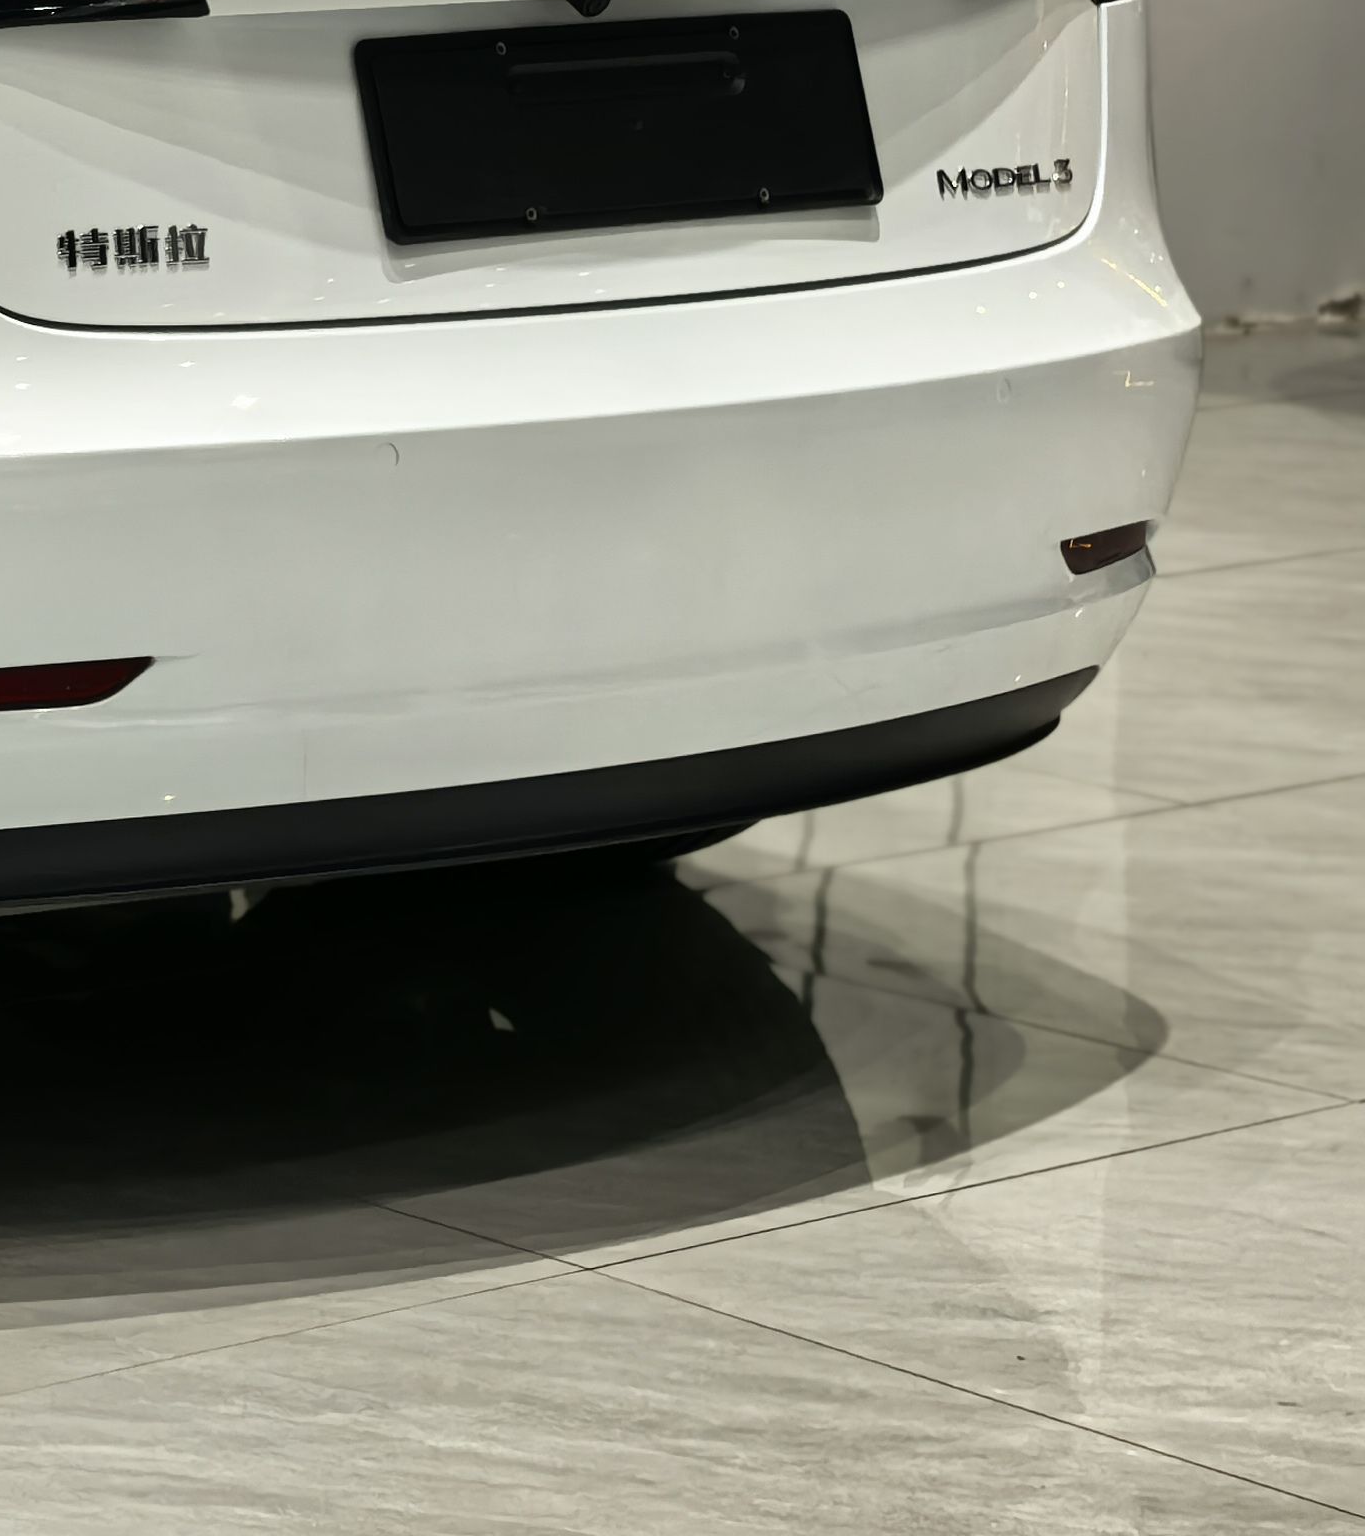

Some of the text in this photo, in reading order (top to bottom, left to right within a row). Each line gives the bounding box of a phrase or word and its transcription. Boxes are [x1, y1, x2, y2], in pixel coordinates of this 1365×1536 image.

[936, 158, 1073, 194] MODEL 3
[57, 224, 210, 268] 特斯拉
